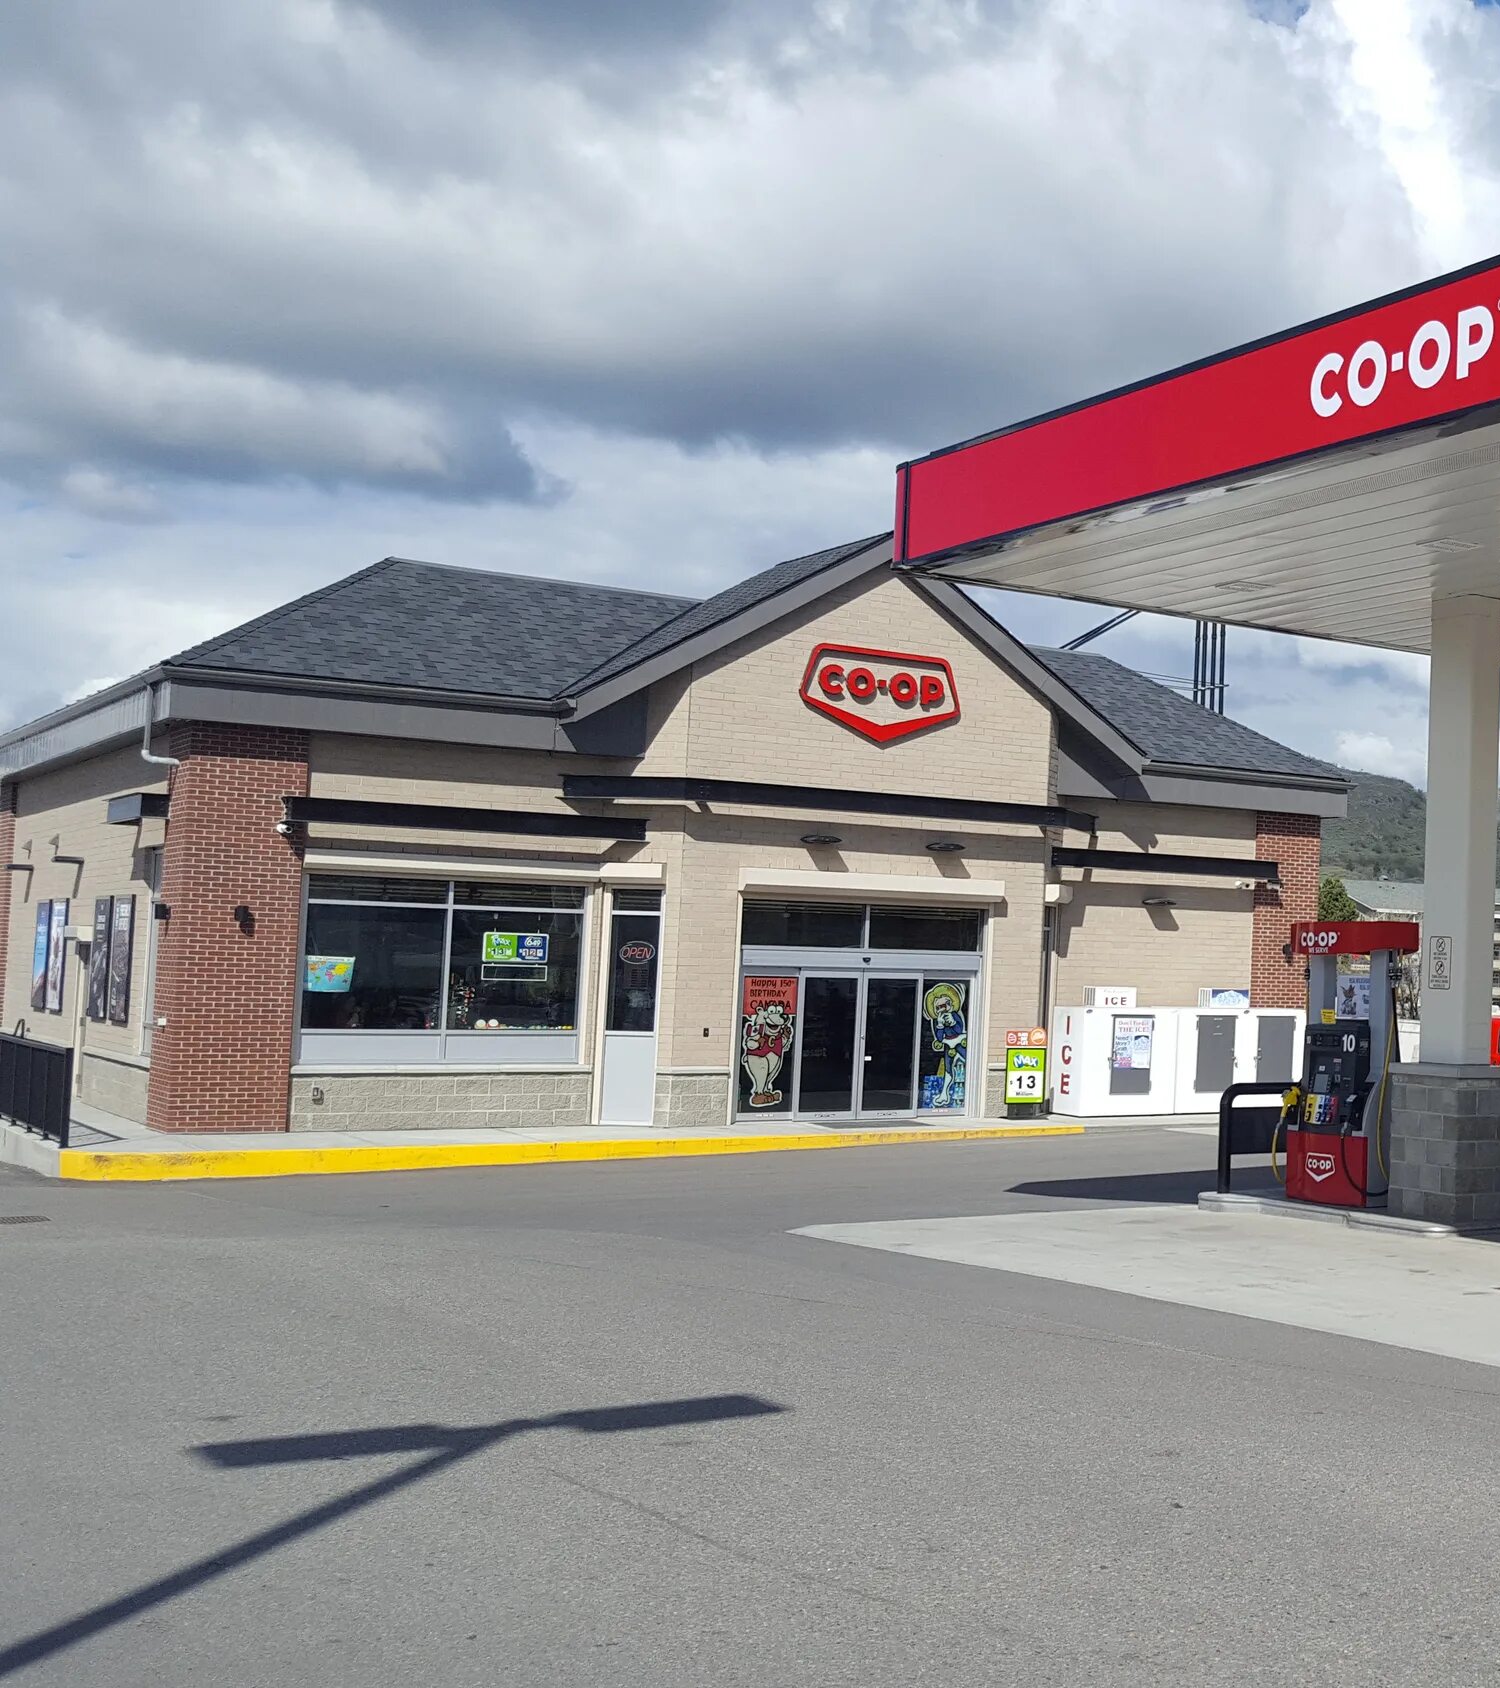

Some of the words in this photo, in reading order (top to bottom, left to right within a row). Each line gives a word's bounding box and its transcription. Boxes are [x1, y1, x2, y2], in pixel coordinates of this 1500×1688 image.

[1310, 306, 1494, 417] CO-OP
[818, 664, 944, 704] CO-OP
[1301, 931, 1338, 947] CO-OP
[621, 947, 652, 959] OPEN
[751, 979, 777, 988] Happy
[750, 989, 788, 997] BIRTHDAY
[1105, 997, 1127, 1005] ICE
[1342, 1034, 1356, 1052] 10
[1061, 1015, 1072, 1095] ICE
[1307, 1158, 1331, 1170] CO-OP
